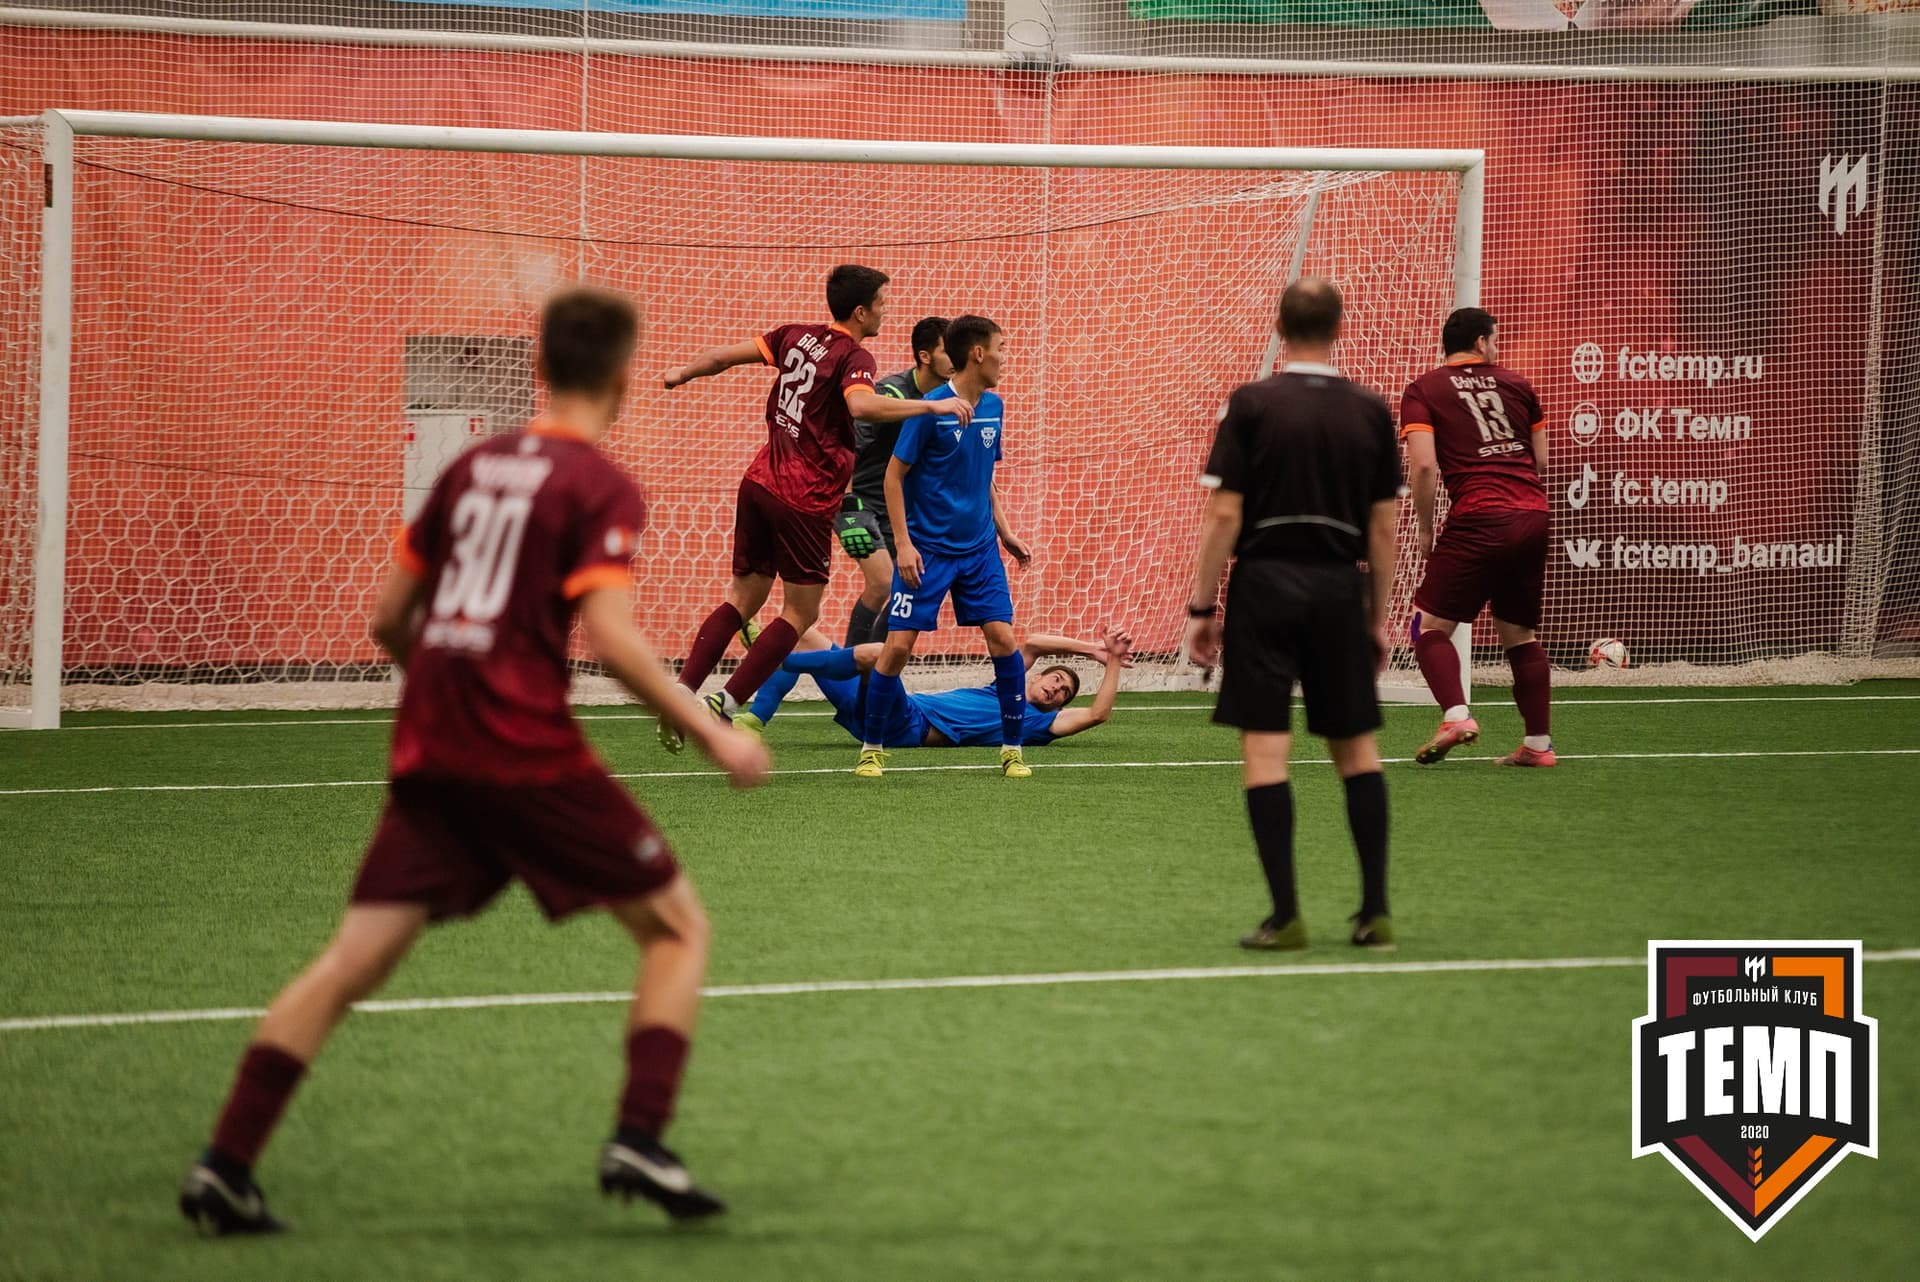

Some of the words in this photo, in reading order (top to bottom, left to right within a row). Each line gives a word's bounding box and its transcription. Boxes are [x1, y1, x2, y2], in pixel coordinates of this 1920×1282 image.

[778, 347, 817, 424] 22
[1617, 347, 1763, 388] fctemp.ru
[1457, 391, 1515, 442] 13
[1614, 407, 1664, 440] ФК
[1671, 408, 1751, 440] Темп
[1612, 471, 1728, 512] fc.temp
[432, 489, 533, 624] 30
[1611, 534, 1843, 577] fctemp_barnaul
[891, 591, 914, 618] 25
